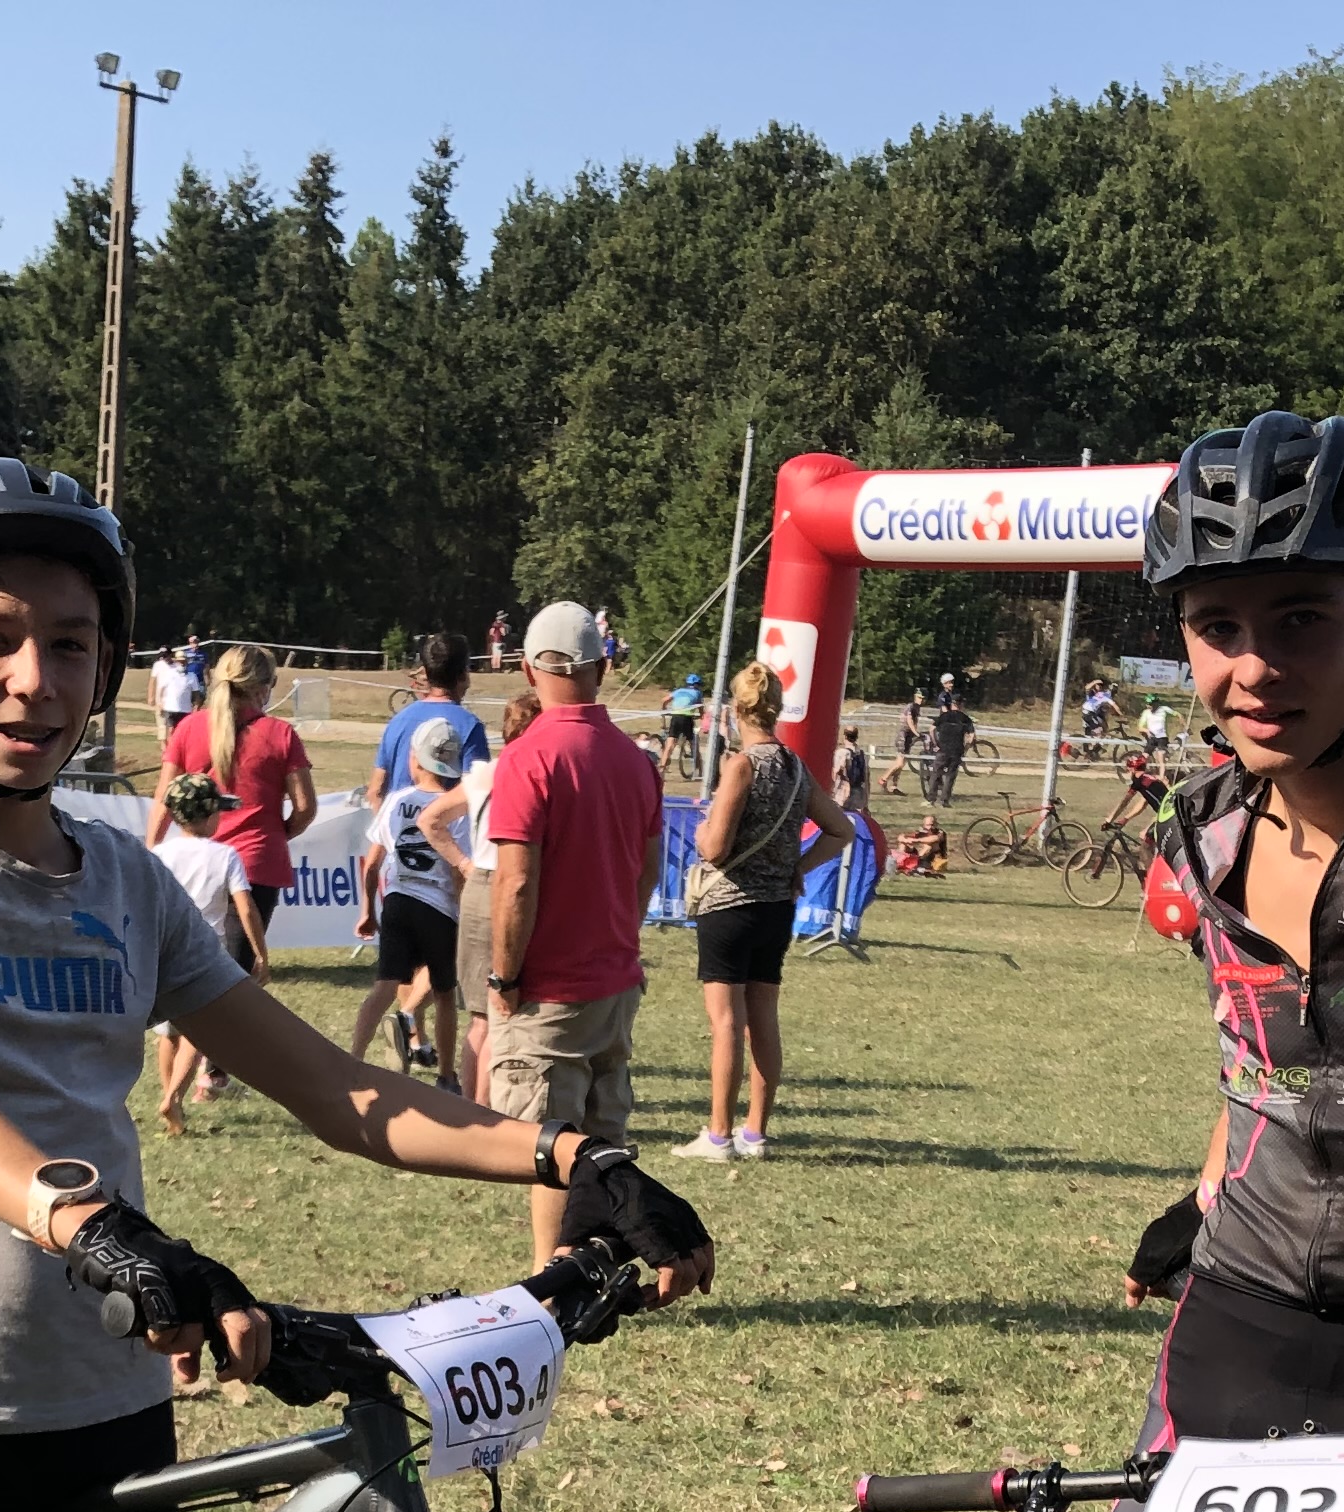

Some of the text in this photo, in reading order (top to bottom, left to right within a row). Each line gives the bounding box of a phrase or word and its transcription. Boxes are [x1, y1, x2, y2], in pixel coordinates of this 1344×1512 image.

[859, 494, 1153, 541] Crédit Mutuel
[444, 1356, 549, 1426] 603.4
